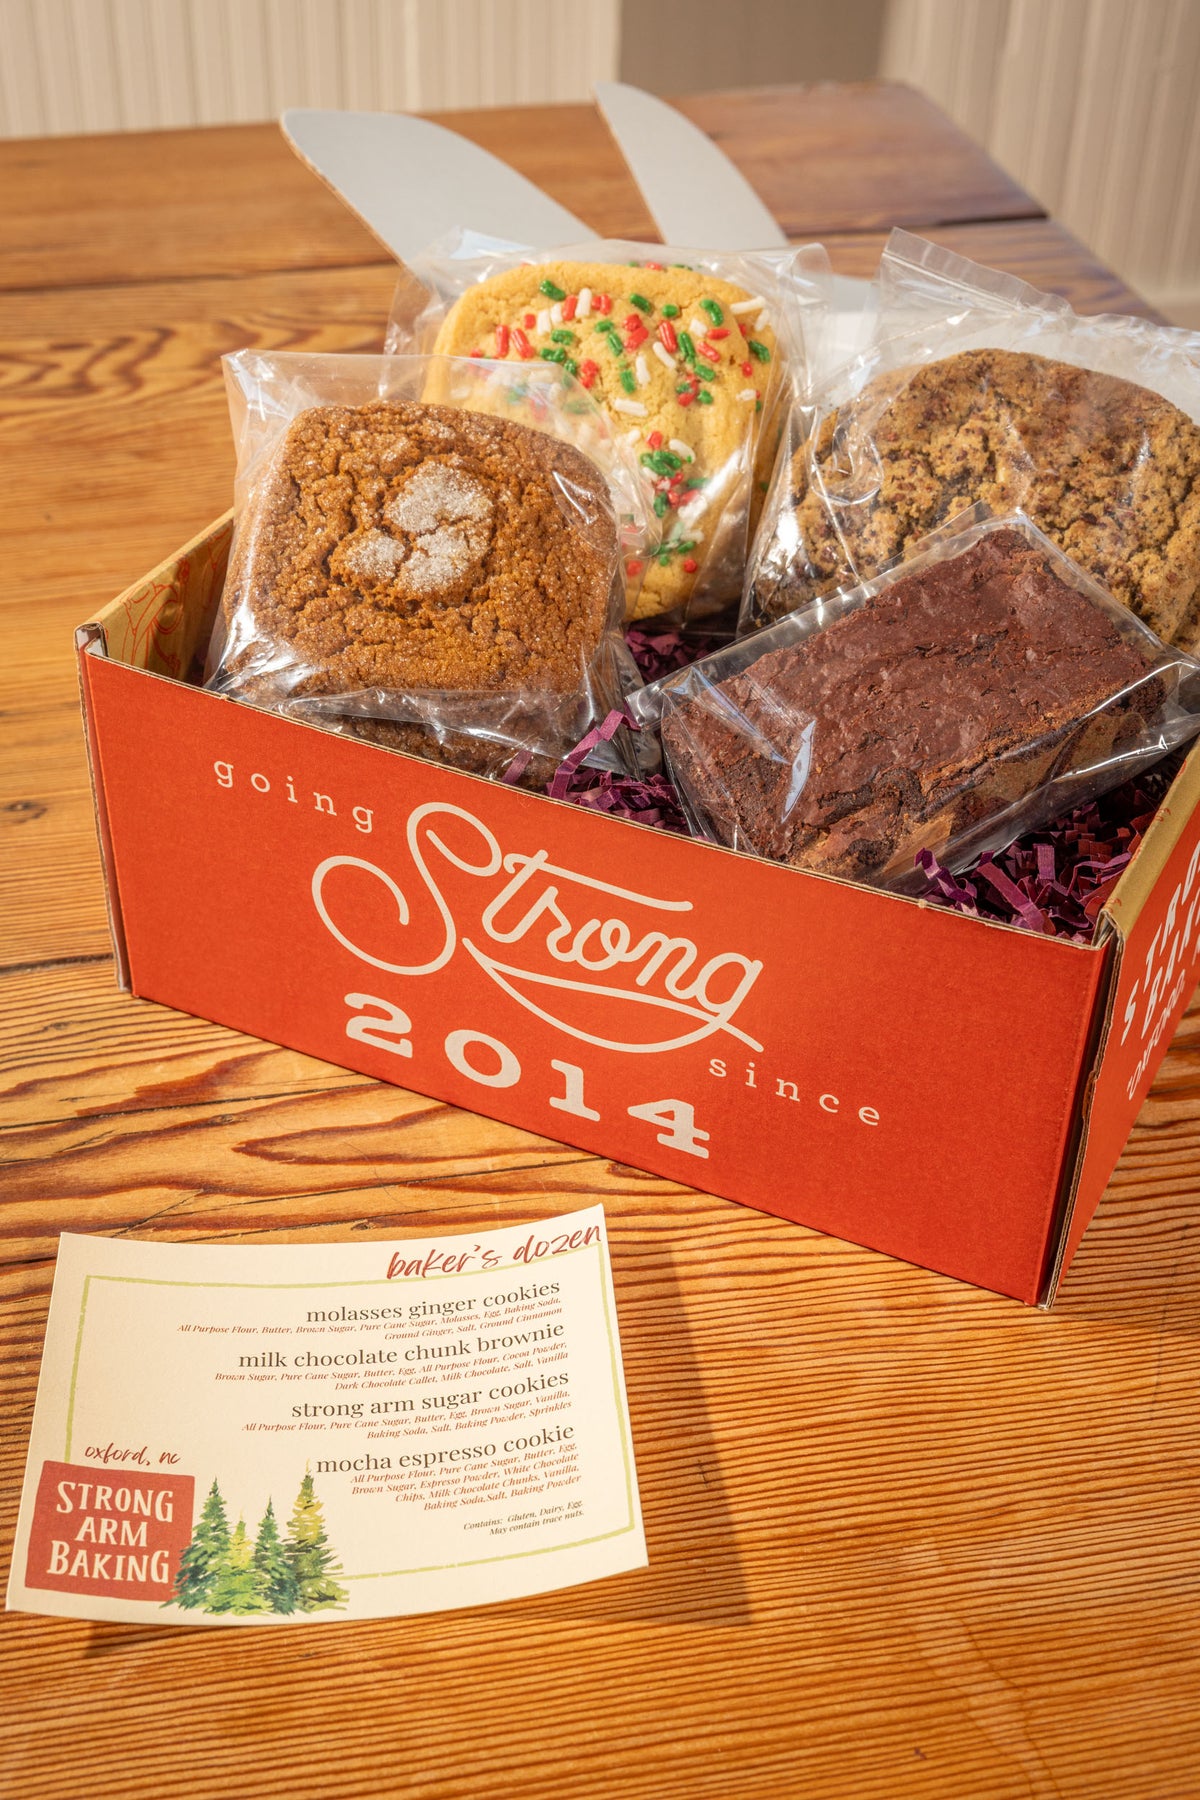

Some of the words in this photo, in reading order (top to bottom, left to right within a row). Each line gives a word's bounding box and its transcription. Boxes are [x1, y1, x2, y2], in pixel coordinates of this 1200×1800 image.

[213, 758, 375, 833] going
[311, 802, 764, 1054] Strong
[1121, 839, 1200, 1046] STRO
[344, 992, 710, 1160] 2014
[709, 1057, 881, 1127] since
[512, 1225, 602, 1264] dozen
[176, 1324, 192, 1332] All
[192, 1325, 230, 1335] Purpose
[295, 1326, 326, 1334] Brown
[359, 1323, 382, 1331] Pure
[383, 1321, 407, 1330] Cane
[503, 1303, 536, 1315] Baking
[306, 1306, 403, 1323] molasses
[408, 1299, 477, 1319] ginger
[483, 1282, 560, 1308] cookies
[384, 1330, 420, 1341] Ground
[479, 1316, 514, 1330] Ground
[516, 1307, 562, 1323] Cinnamon
[238, 1351, 288, 1368] milk
[294, 1349, 398, 1368] chocolate
[404, 1339, 472, 1362] chunk
[476, 1323, 564, 1353] brownie
[214, 1372, 246, 1383] Brown
[280, 1373, 303, 1381] Pure
[304, 1372, 330, 1382] Cane
[418, 1364, 433, 1373] All
[434, 1361, 471, 1372] Purpose
[502, 1350, 530, 1361] Cocoa
[334, 1381, 359, 1391] Dark
[361, 1379, 407, 1389] Chocolate
[440, 1371, 462, 1382] Milk
[537, 1351, 569, 1365] Vanilla
[291, 1403, 364, 1419] strong
[370, 1399, 415, 1414] arm
[421, 1390, 482, 1410] sugar
[488, 1372, 569, 1400] cookies
[241, 1422, 257, 1431] All
[257, 1423, 297, 1432] Purpose
[329, 1421, 352, 1430] Pure
[354, 1420, 380, 1429] Cane
[470, 1405, 501, 1417] Brown
[367, 1429, 401, 1439] Baking
[454, 1419, 489, 1430] Baking
[528, 1401, 572, 1417] Sprinkles
[84, 1443, 151, 1466] oxford,
[159, 1452, 181, 1464] nc
[316, 1453, 393, 1473] mocha
[398, 1442, 497, 1469] espresso
[503, 1425, 575, 1453] cookie
[350, 1474, 365, 1484] All
[366, 1472, 406, 1483] Purpose
[439, 1466, 462, 1476] Pure
[463, 1462, 489, 1472] Cane
[351, 1486, 384, 1495] Brown
[419, 1477, 461, 1489] Espresso
[503, 1464, 531, 1476] White
[533, 1453, 579, 1470] Chocolate
[423, 1499, 459, 1511] Baking
[510, 1484, 545, 1497] Baking
[546, 1475, 582, 1490] Powder
[428, 1488, 451, 1499] Milk
[453, 1482, 500, 1496] Chocolate
[56, 1481, 173, 1522] STRONG
[75, 1516, 148, 1547] ARM
[47, 1540, 169, 1584] BAKING
